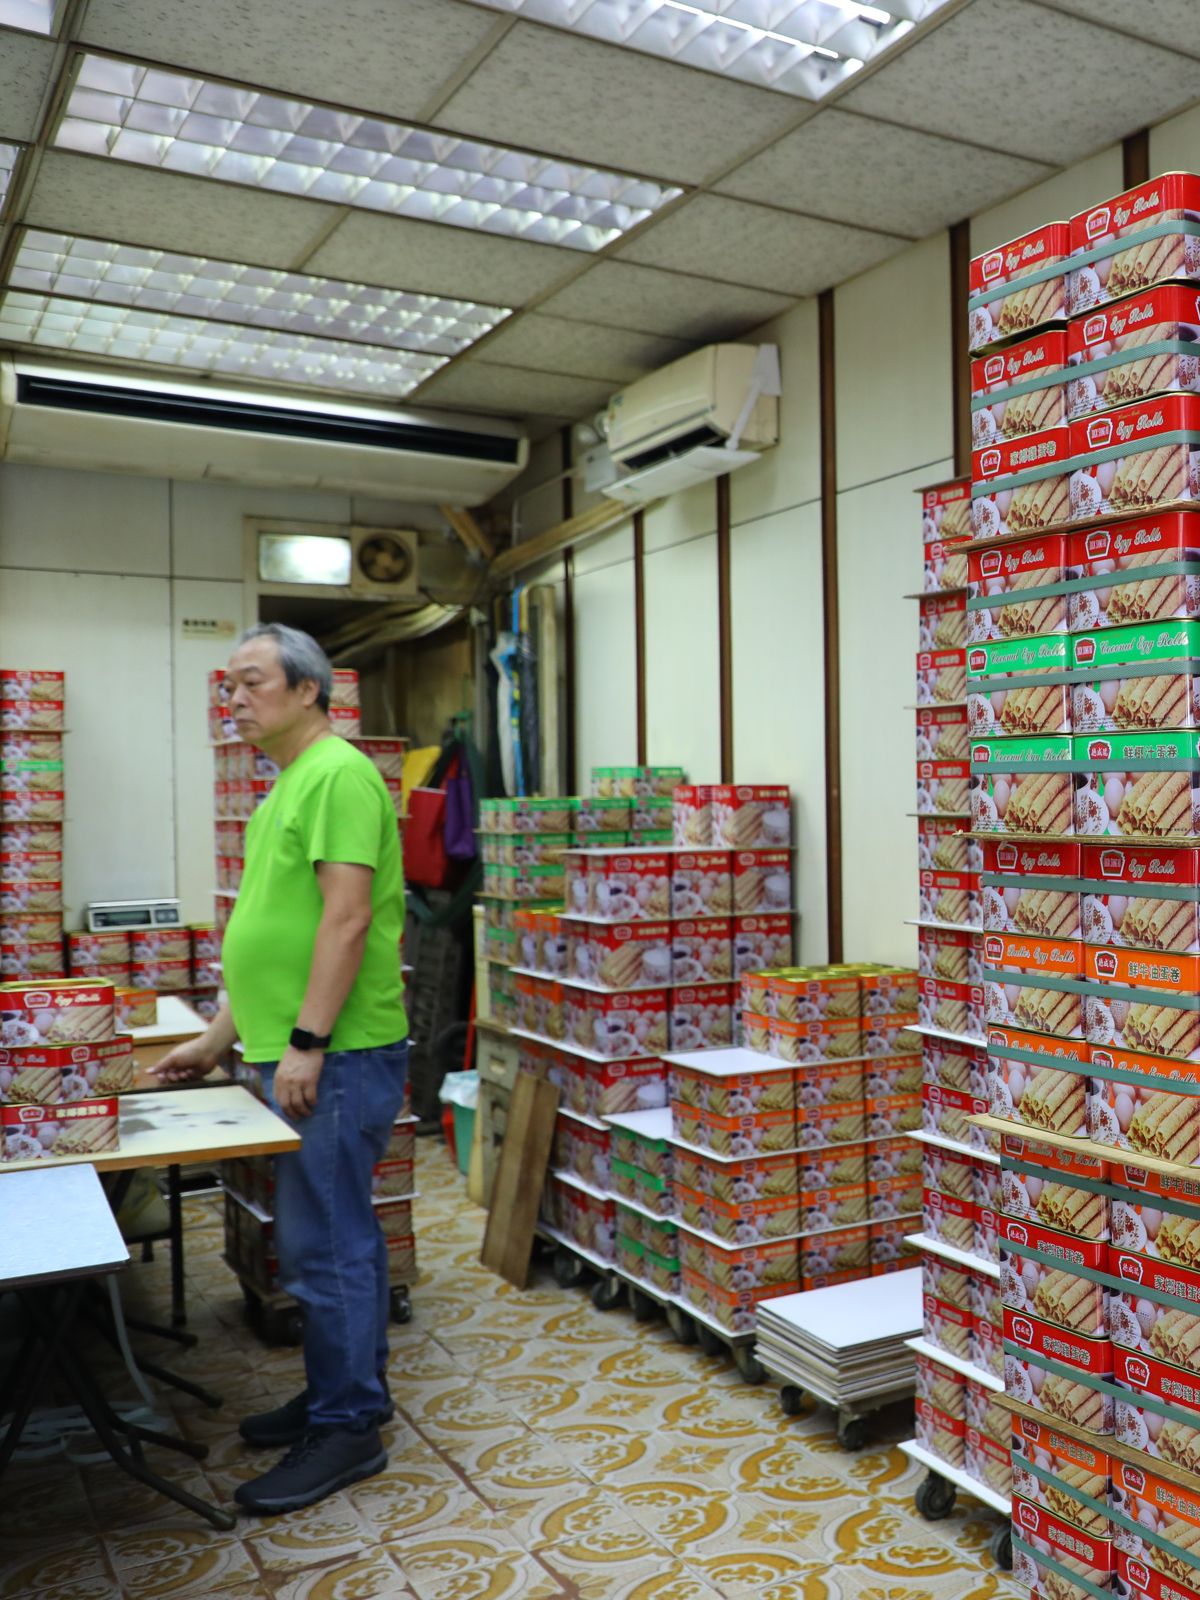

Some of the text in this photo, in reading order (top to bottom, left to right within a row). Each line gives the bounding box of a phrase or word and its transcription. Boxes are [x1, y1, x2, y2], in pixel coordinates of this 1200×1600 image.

[1116, 411, 1163, 440] Egg Rolls
[1114, 528, 1161, 553] Egg Rolls
[1137, 636, 1154, 653] Egg
[1129, 858, 1175, 878] Egg Rolls
[1128, 962, 1180, 983] 鮮牛油蛋卷
